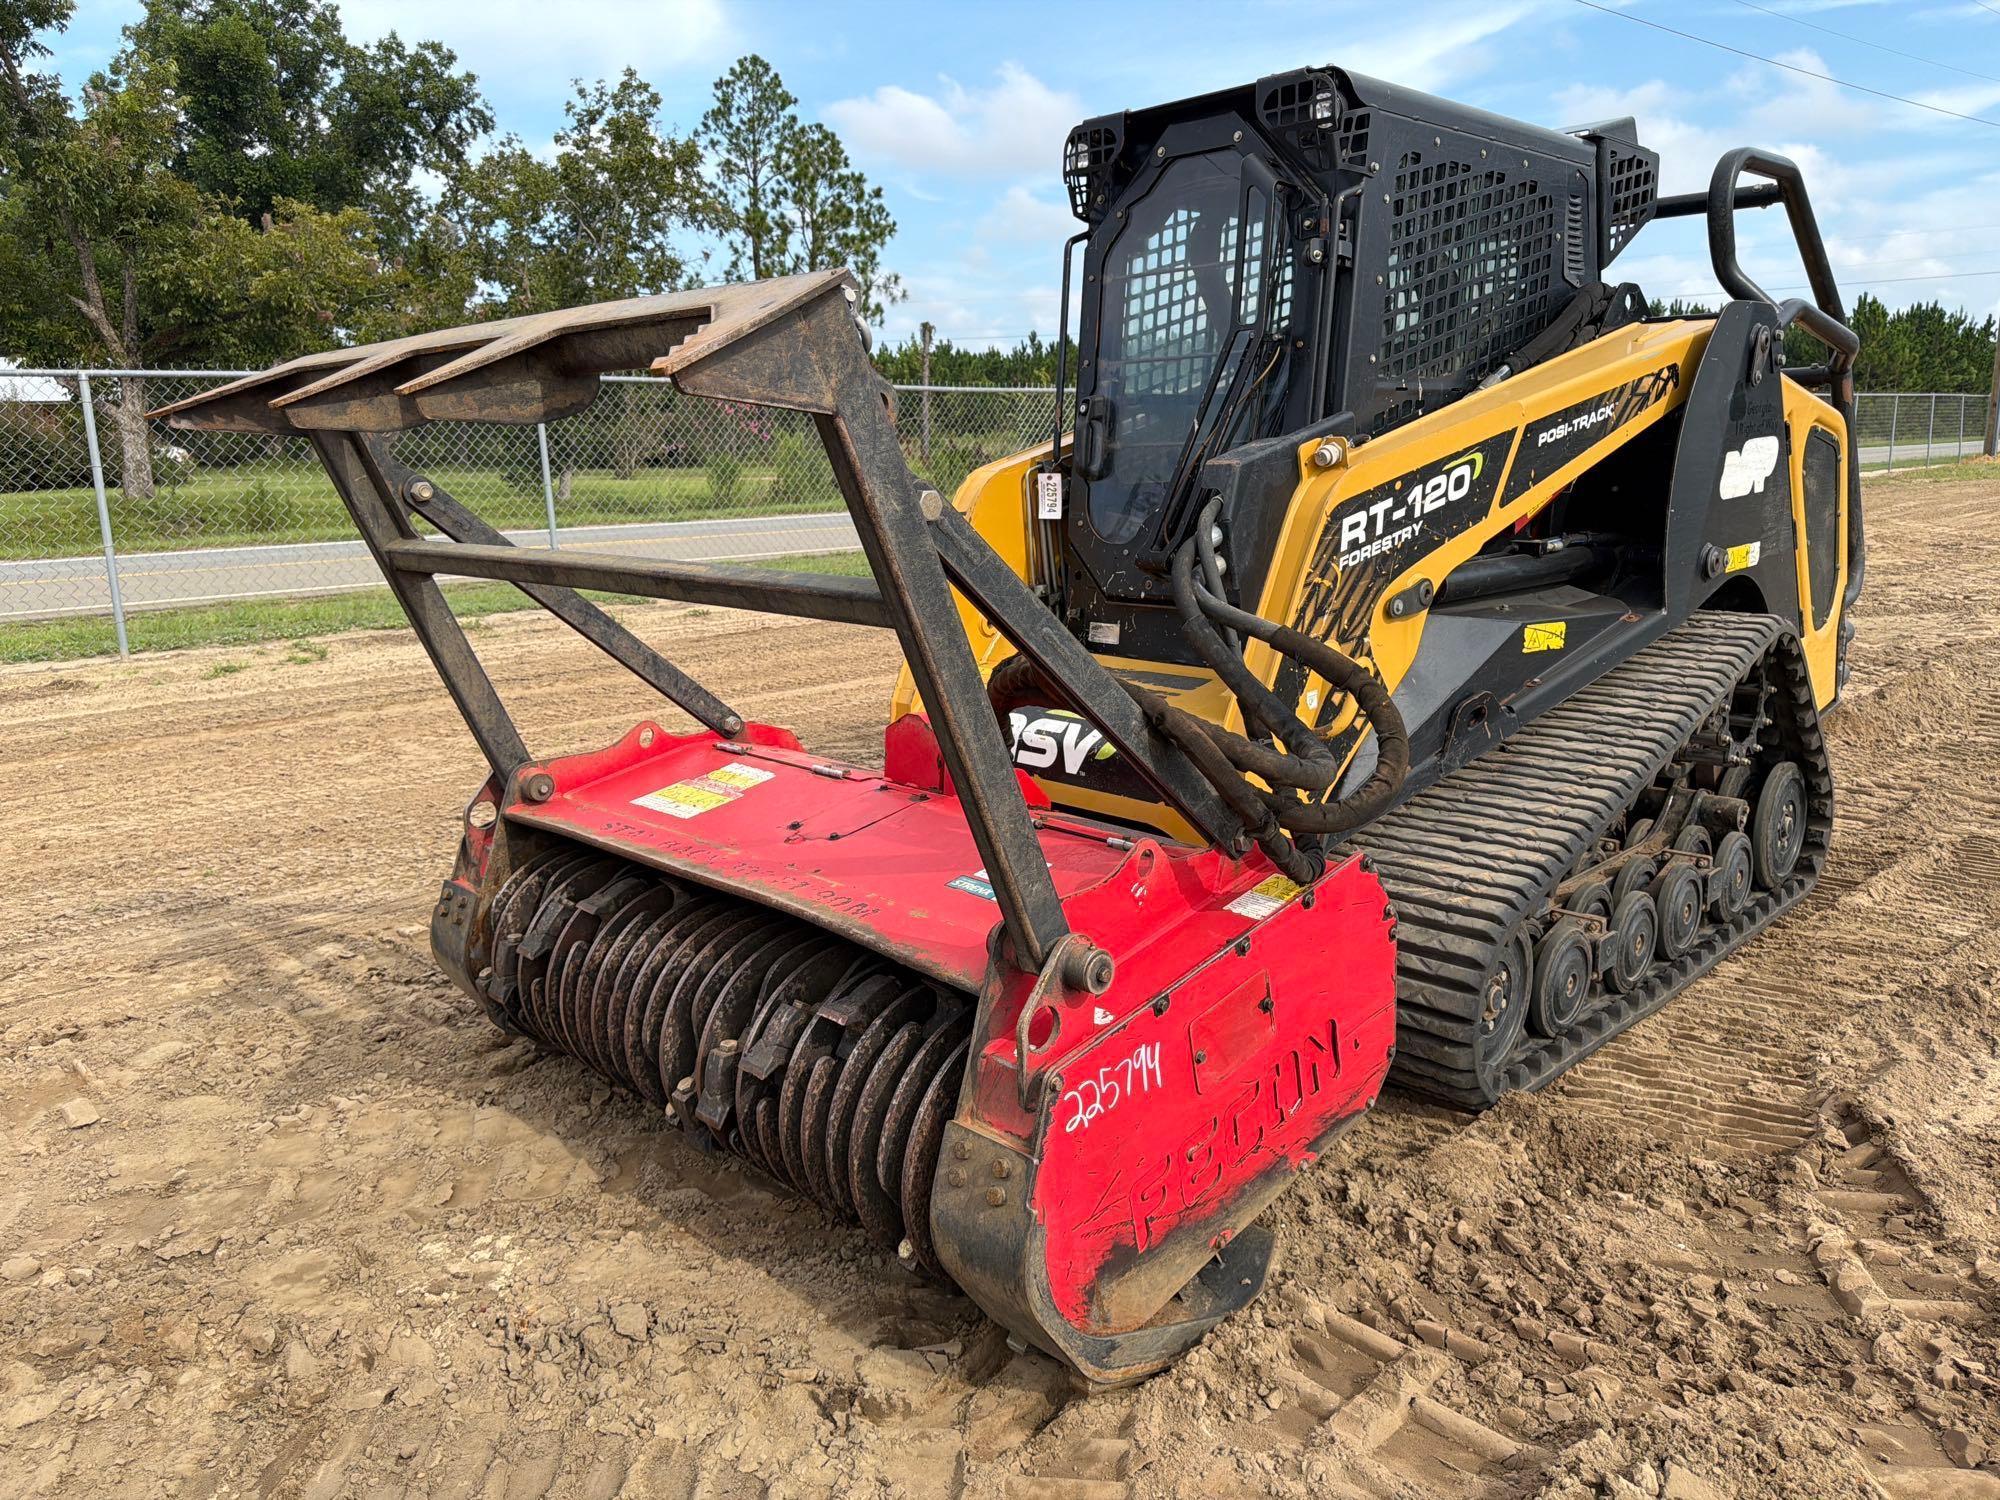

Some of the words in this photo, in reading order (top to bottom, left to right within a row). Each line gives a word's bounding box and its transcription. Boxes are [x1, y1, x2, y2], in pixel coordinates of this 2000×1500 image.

[1538, 403, 1615, 447] POSI-TRACK
[1046, 482, 1058, 513] 225794
[1340, 464, 1471, 552] RT-120
[1338, 520, 1424, 571] FORESTRY
[1064, 1041, 1162, 1132] 225794
